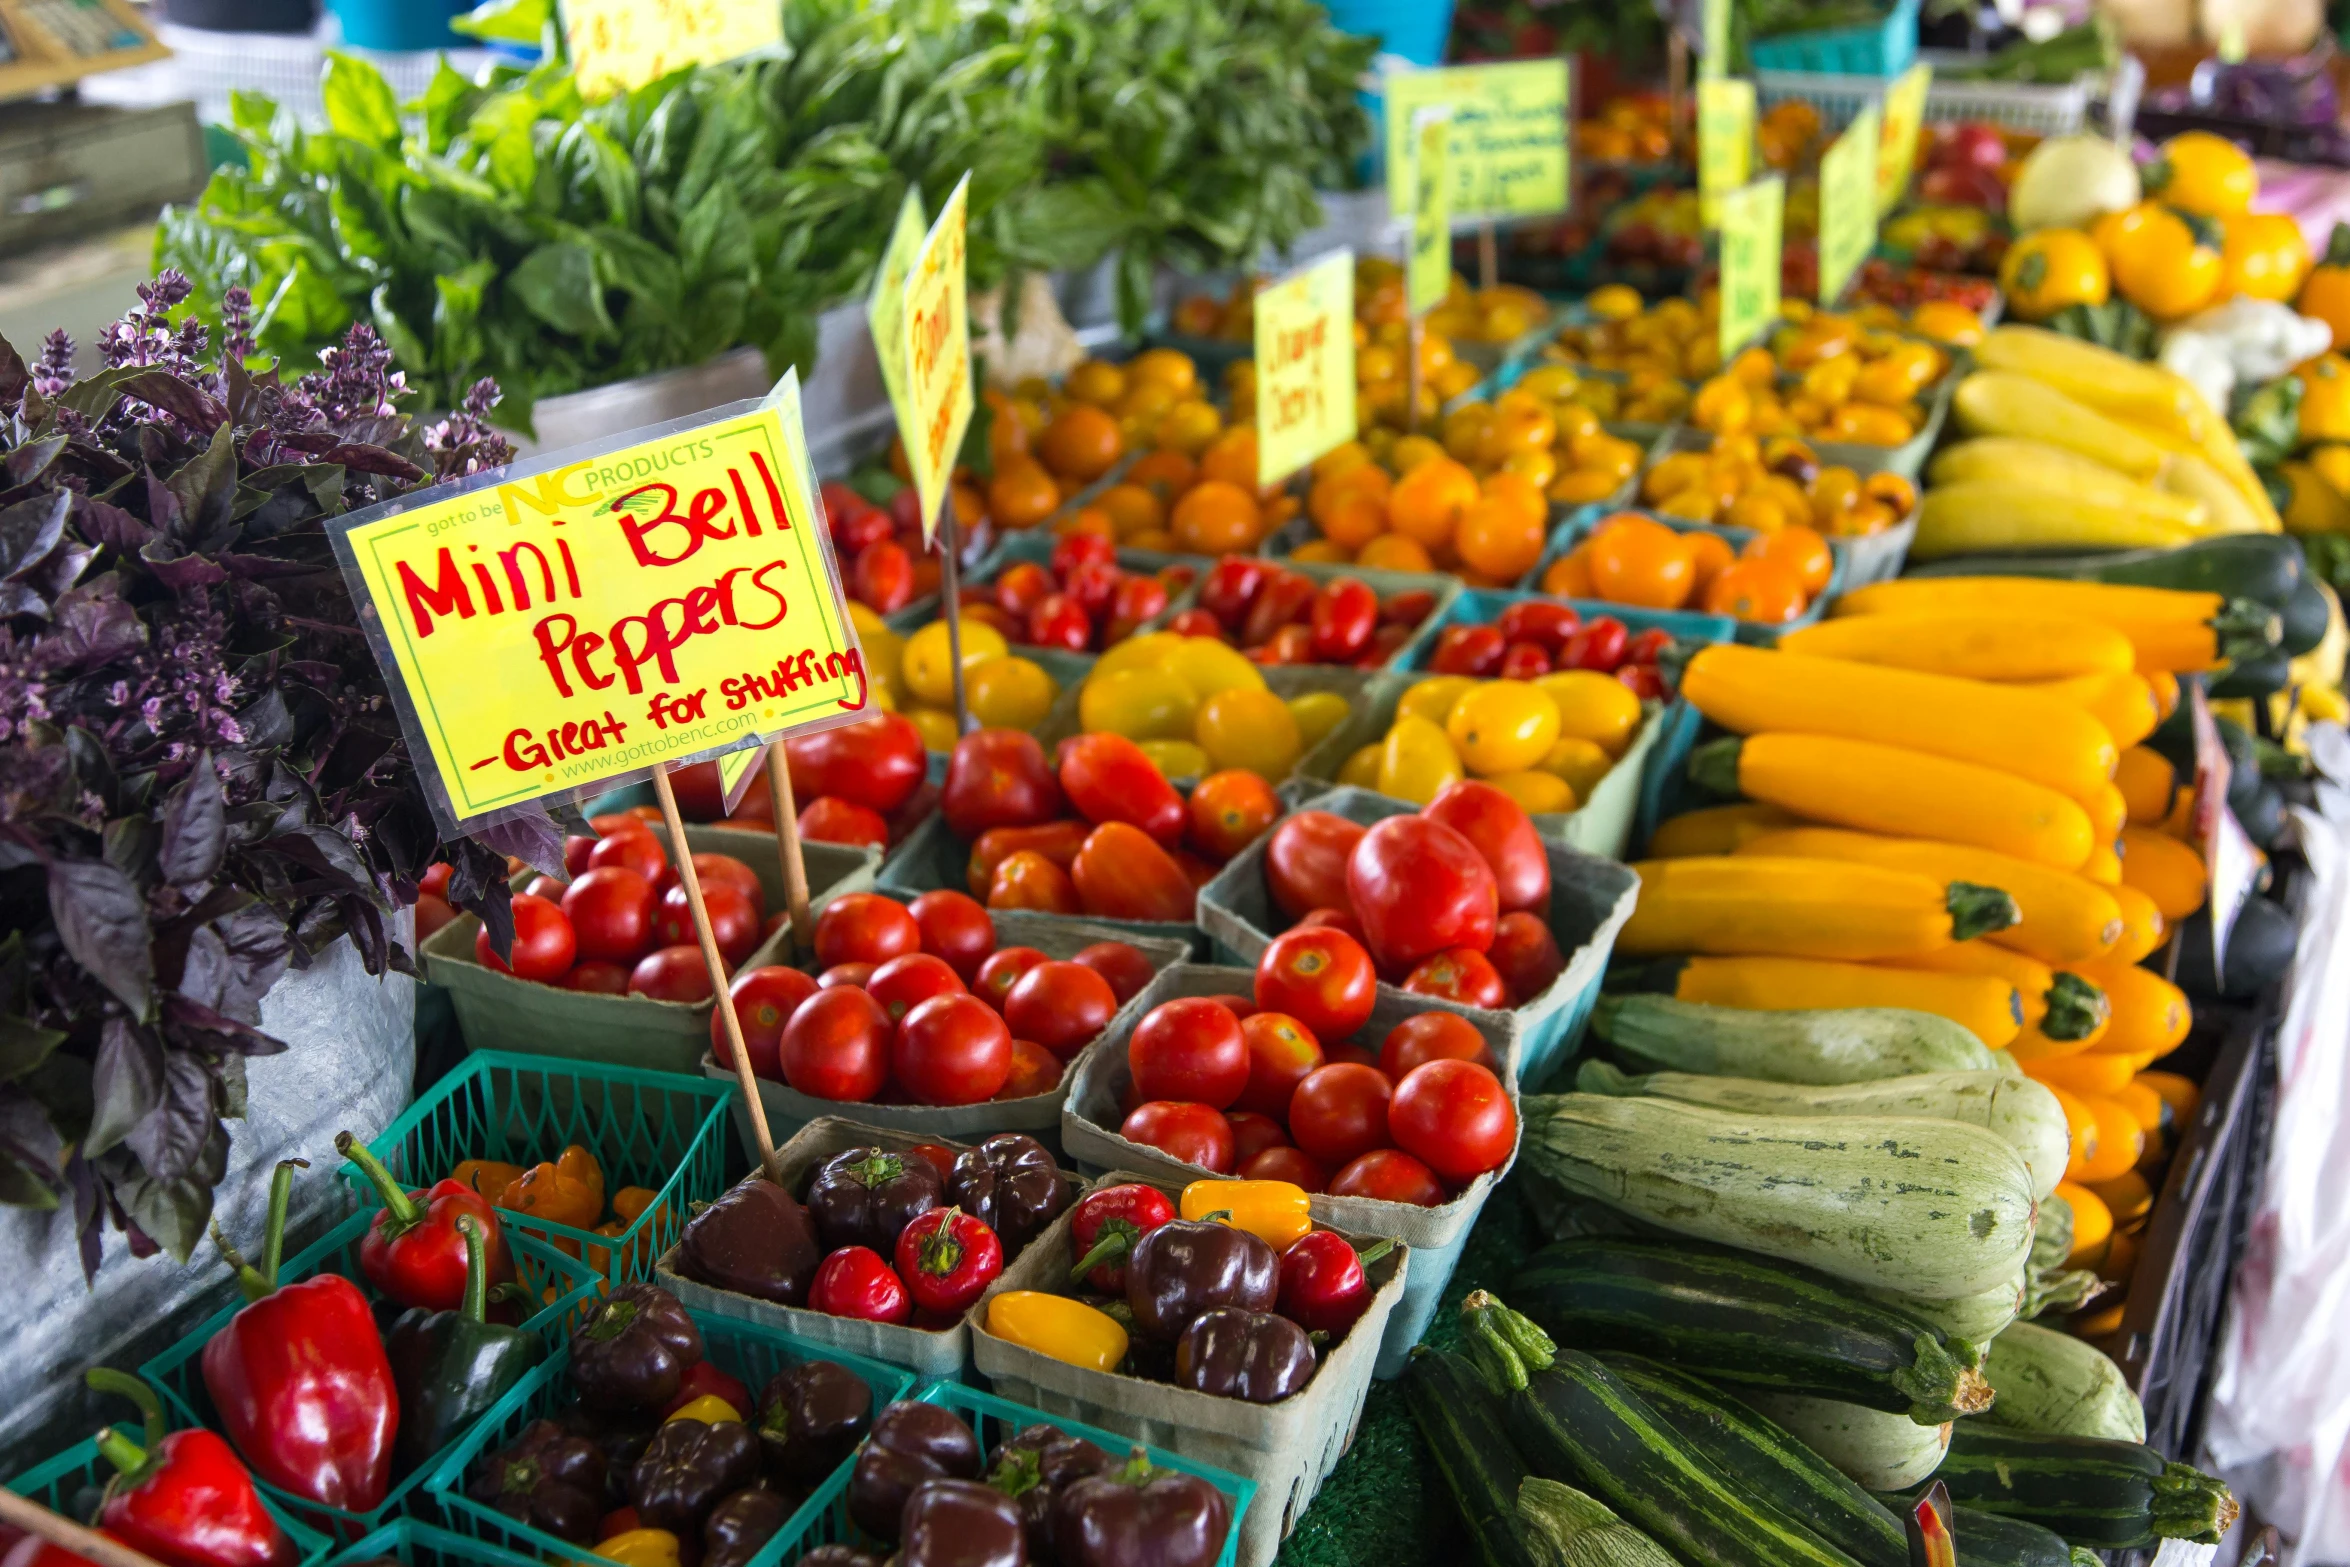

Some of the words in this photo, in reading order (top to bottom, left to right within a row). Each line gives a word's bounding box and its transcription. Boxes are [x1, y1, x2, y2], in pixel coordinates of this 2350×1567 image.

[427, 515, 457, 537] got
[459, 512, 476, 523] to
[480, 503, 502, 518] be
[497, 459, 605, 526] NC
[584, 439, 713, 491] PRODUCTS
[395, 521, 582, 638] Mini
[610, 451, 791, 567] Bell
[533, 560, 788, 699] Peppers
[561, 710, 758, 779] www.gottobenc.com
[647, 688, 708, 730] for
